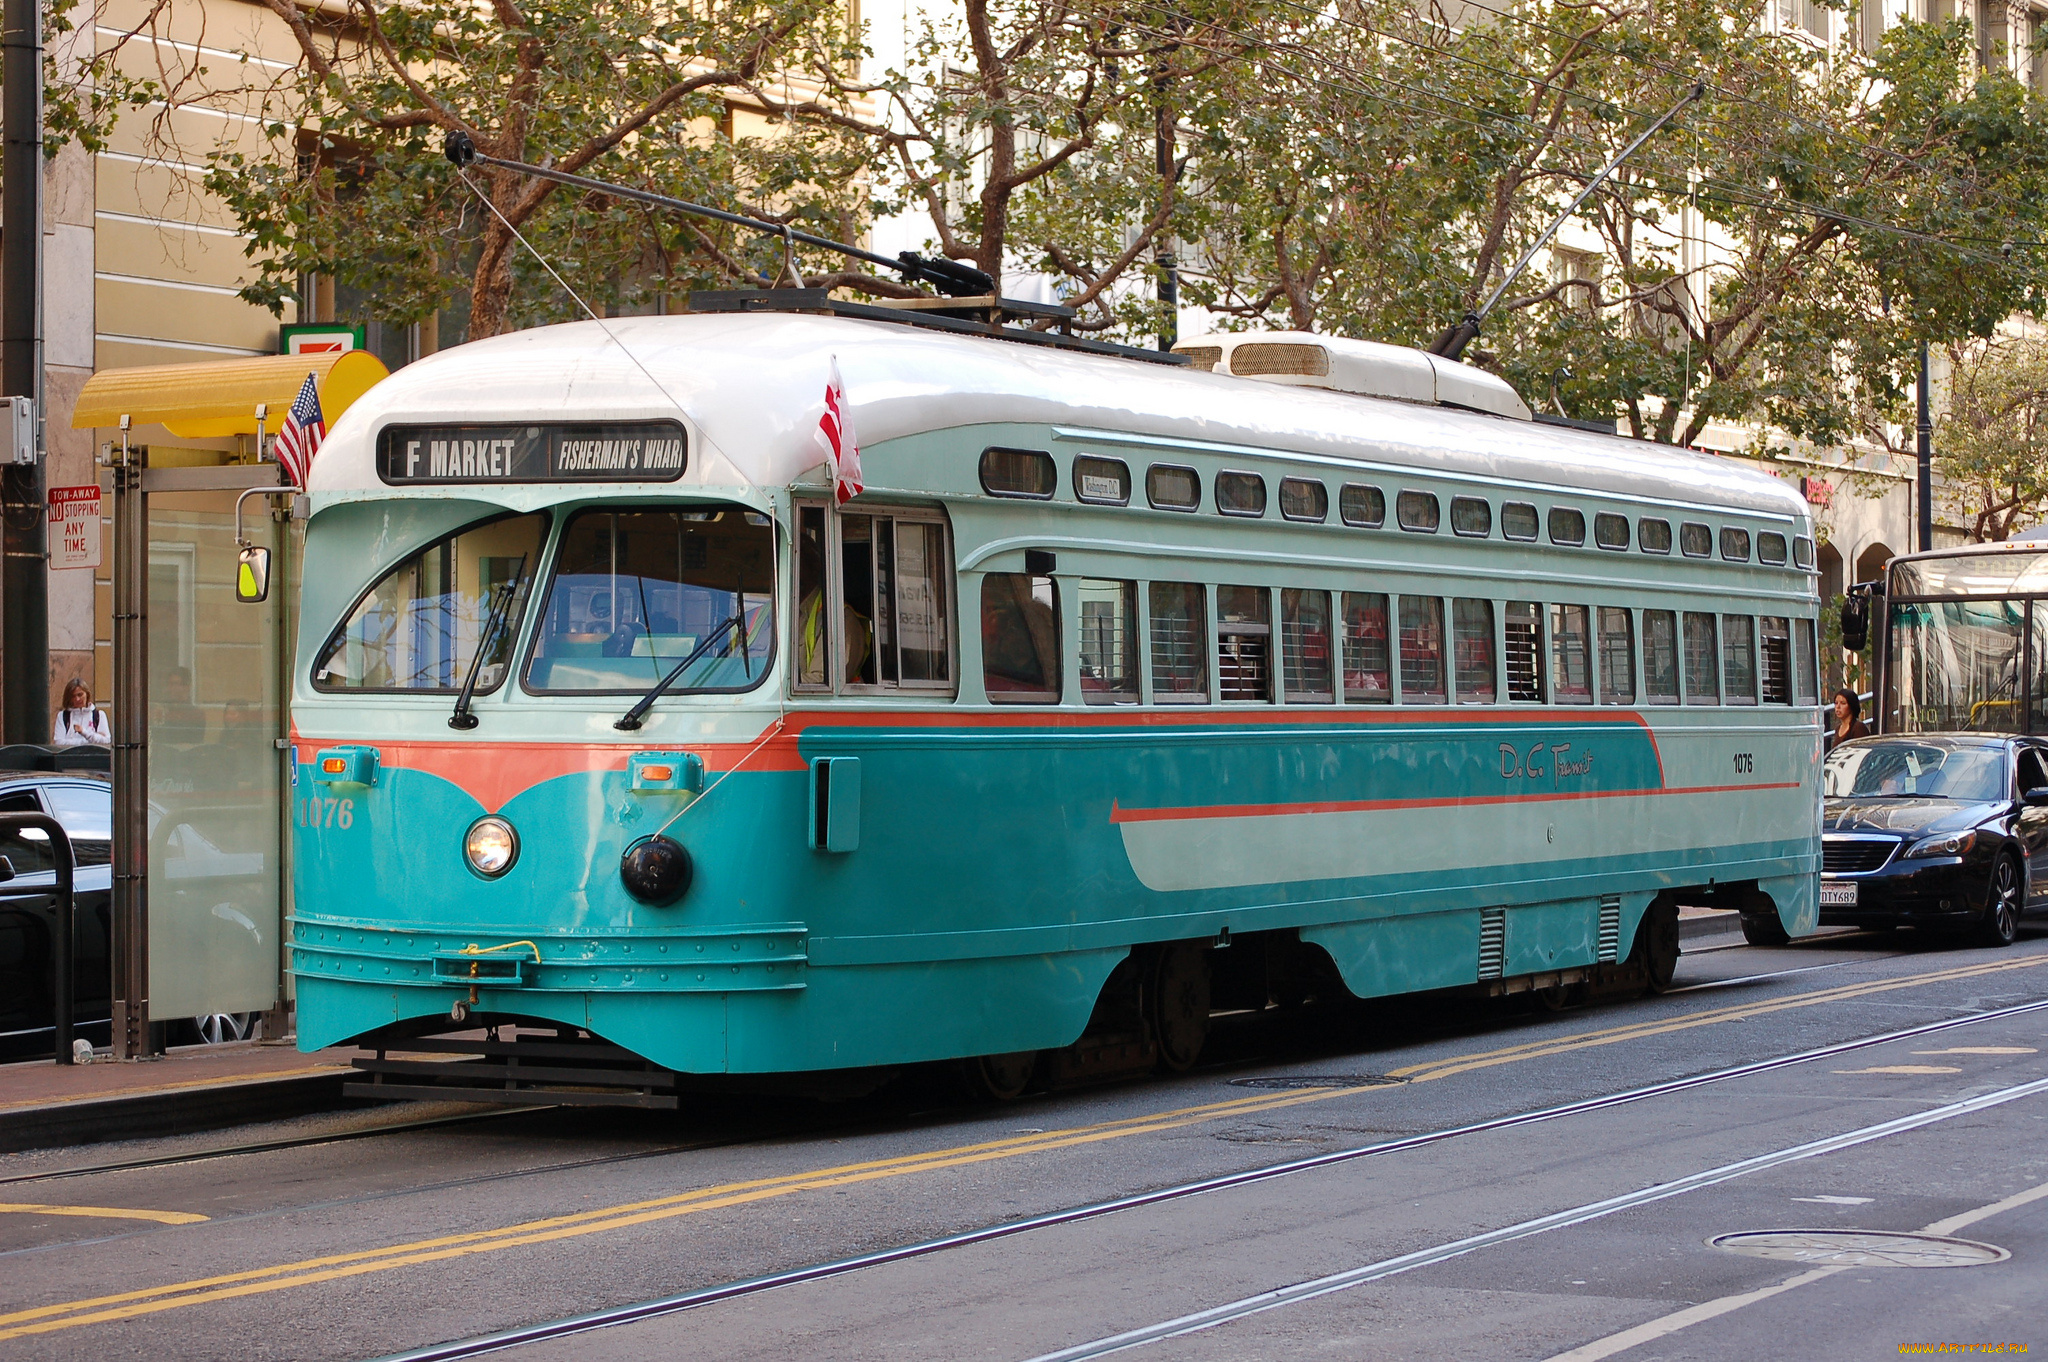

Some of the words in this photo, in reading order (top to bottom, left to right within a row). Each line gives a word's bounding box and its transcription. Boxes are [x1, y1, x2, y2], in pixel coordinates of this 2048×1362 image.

[406, 440, 421, 477] F
[430, 439, 515, 477] MARKET
[558, 440, 641, 471] FISHERMAN'S
[53, 488, 96, 501] TOW-AWAY
[50, 502, 64, 521] NO
[65, 502, 99, 518] STOPPING
[65, 521, 85, 536] ANY
[64, 538, 86, 552] TIME
[1498, 742, 1544, 778] D.C.
[1733, 752, 1753, 774] 1076
[300, 797, 354, 830] 1076
[1820, 891, 1855, 902] DTY689
